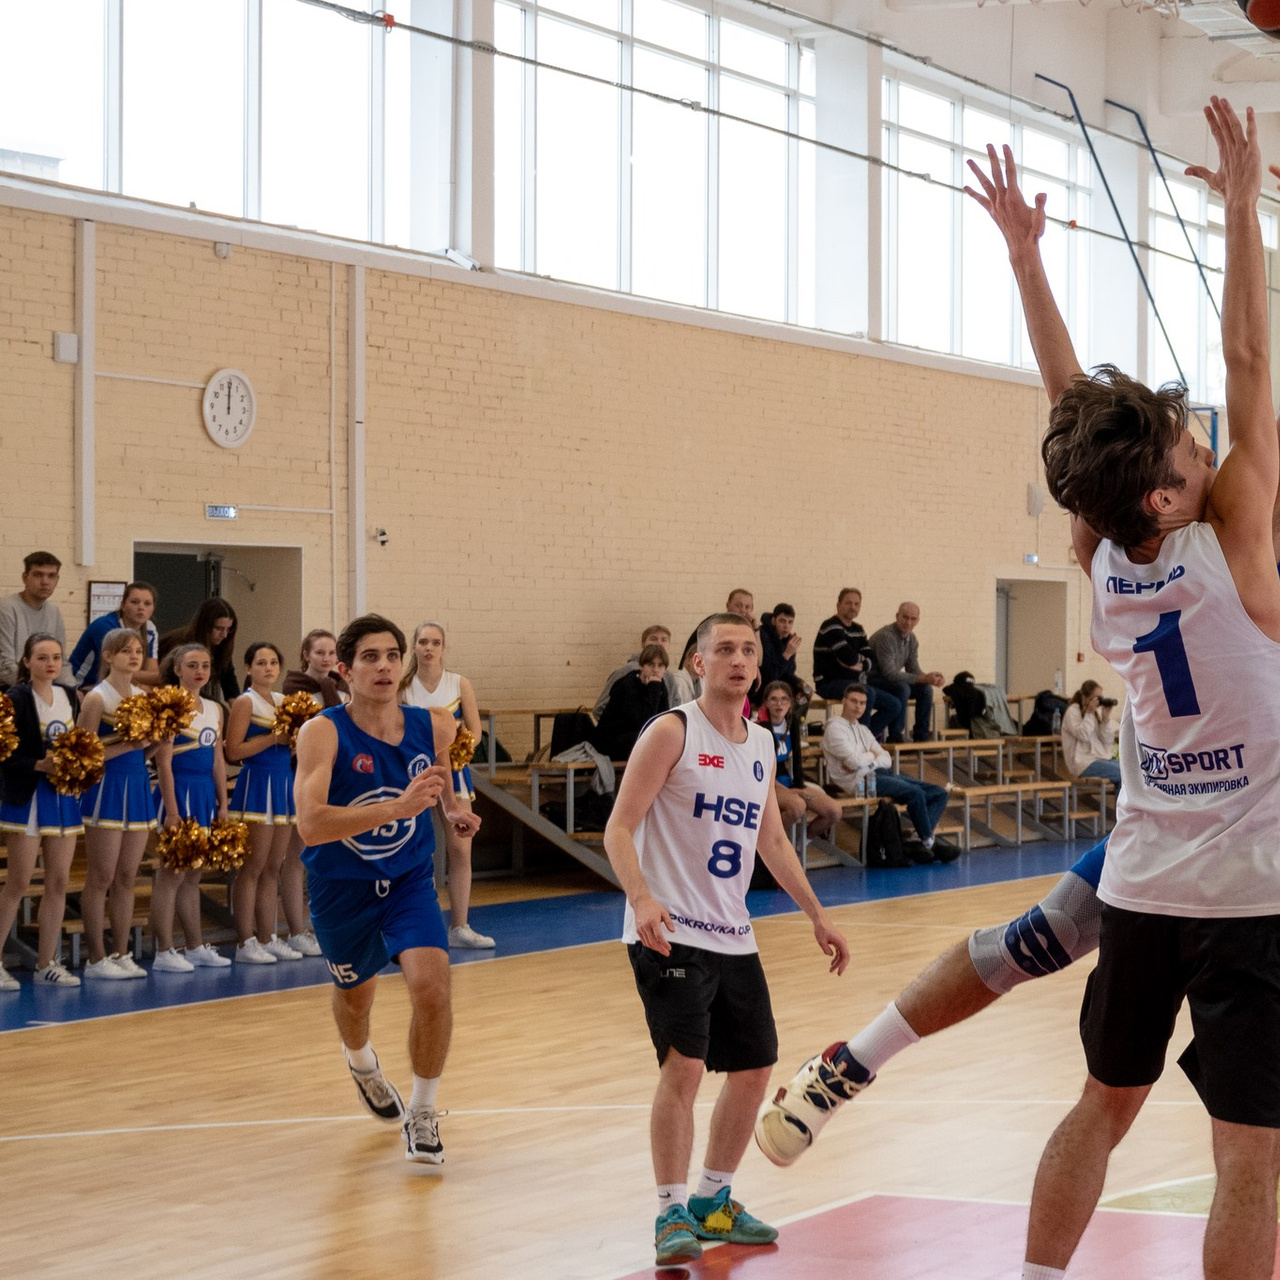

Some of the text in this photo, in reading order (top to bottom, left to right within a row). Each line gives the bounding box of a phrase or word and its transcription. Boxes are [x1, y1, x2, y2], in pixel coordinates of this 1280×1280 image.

[1133, 610, 1201, 718] 1
[1166, 743, 1245, 774] SPORT
[1187, 775, 1250, 795] ЭКИПИРОВКА
[693, 792, 761, 830] HSE
[707, 839, 743, 879] 8
[669, 913, 751, 935] POKROVKA CUP
[326, 959, 359, 983] 45
